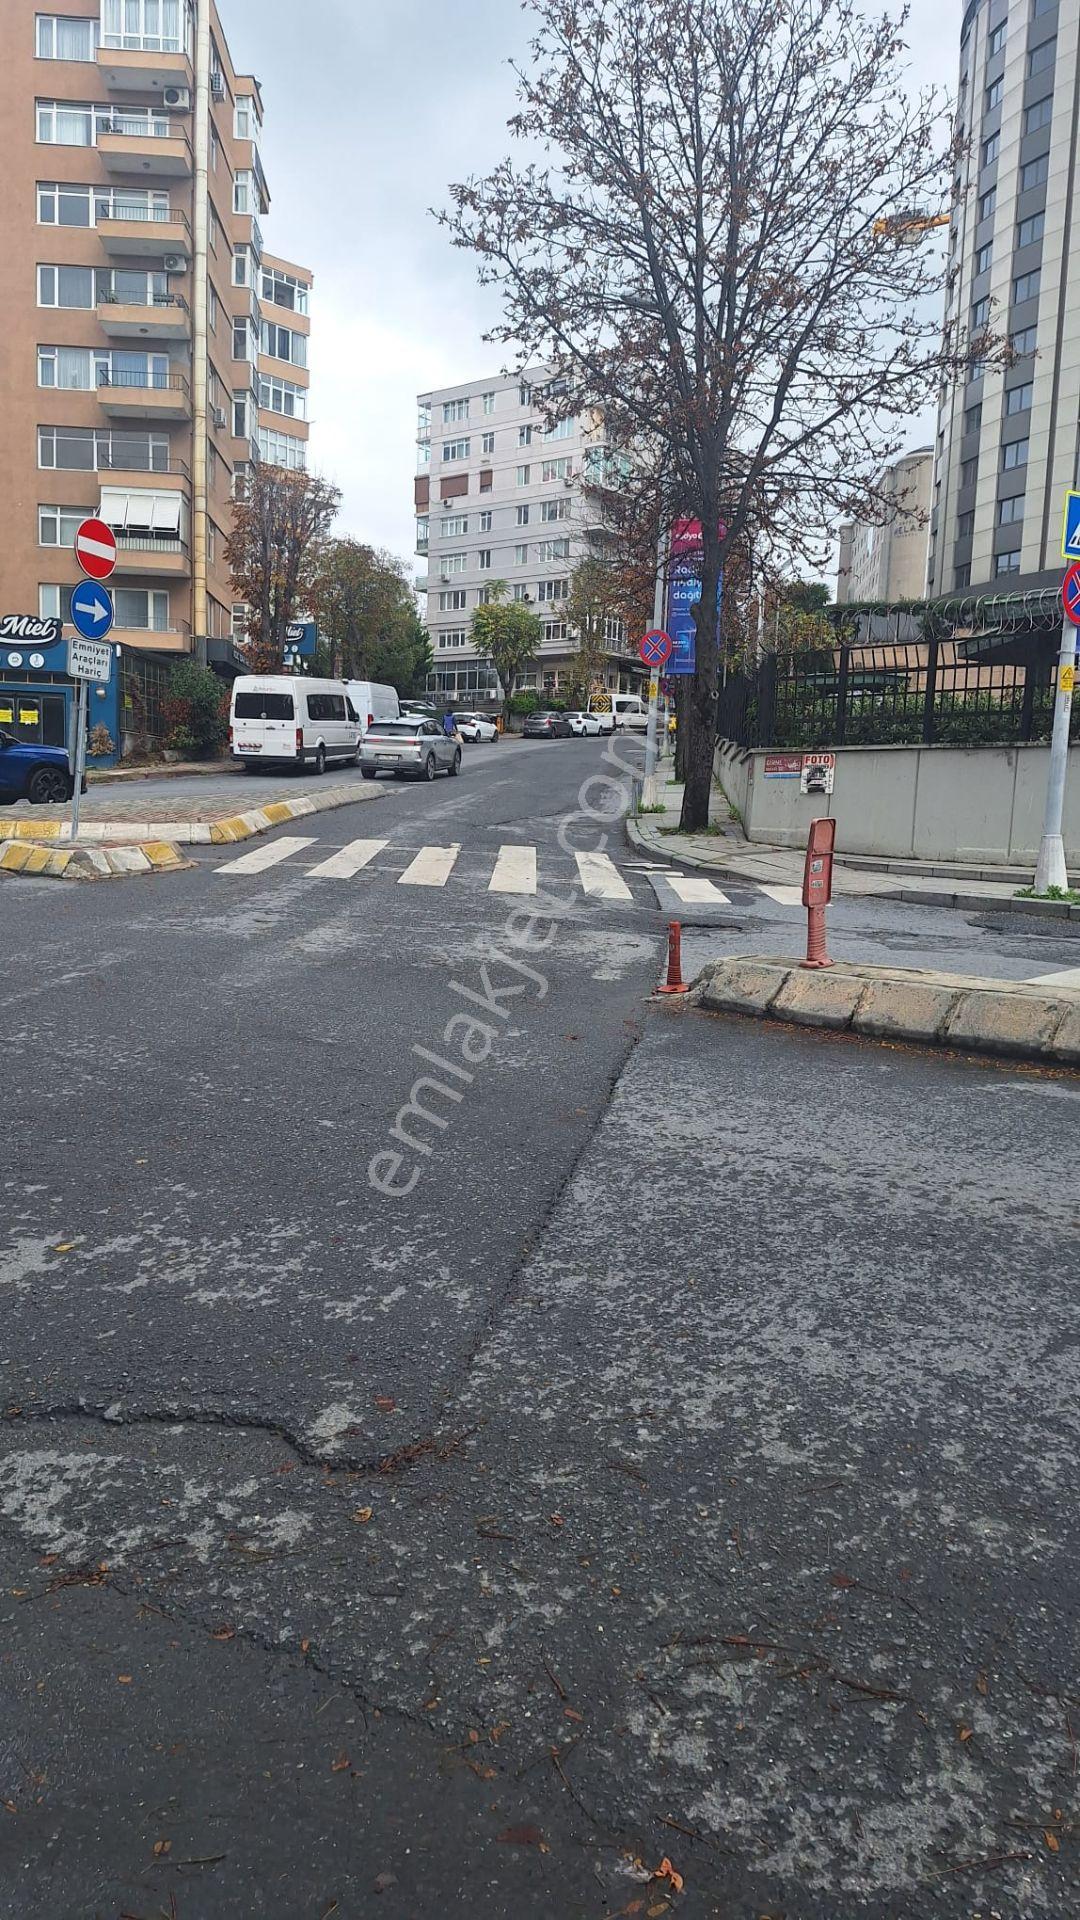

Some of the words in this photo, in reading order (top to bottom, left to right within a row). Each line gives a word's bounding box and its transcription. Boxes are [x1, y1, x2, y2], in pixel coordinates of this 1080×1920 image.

[0, 616, 57, 644] Miel
[72, 640, 109, 656] Emniyet
[72, 652, 108, 667] Araçları
[77, 664, 102, 678] Hariç
[805, 755, 830, 764] FOTO
